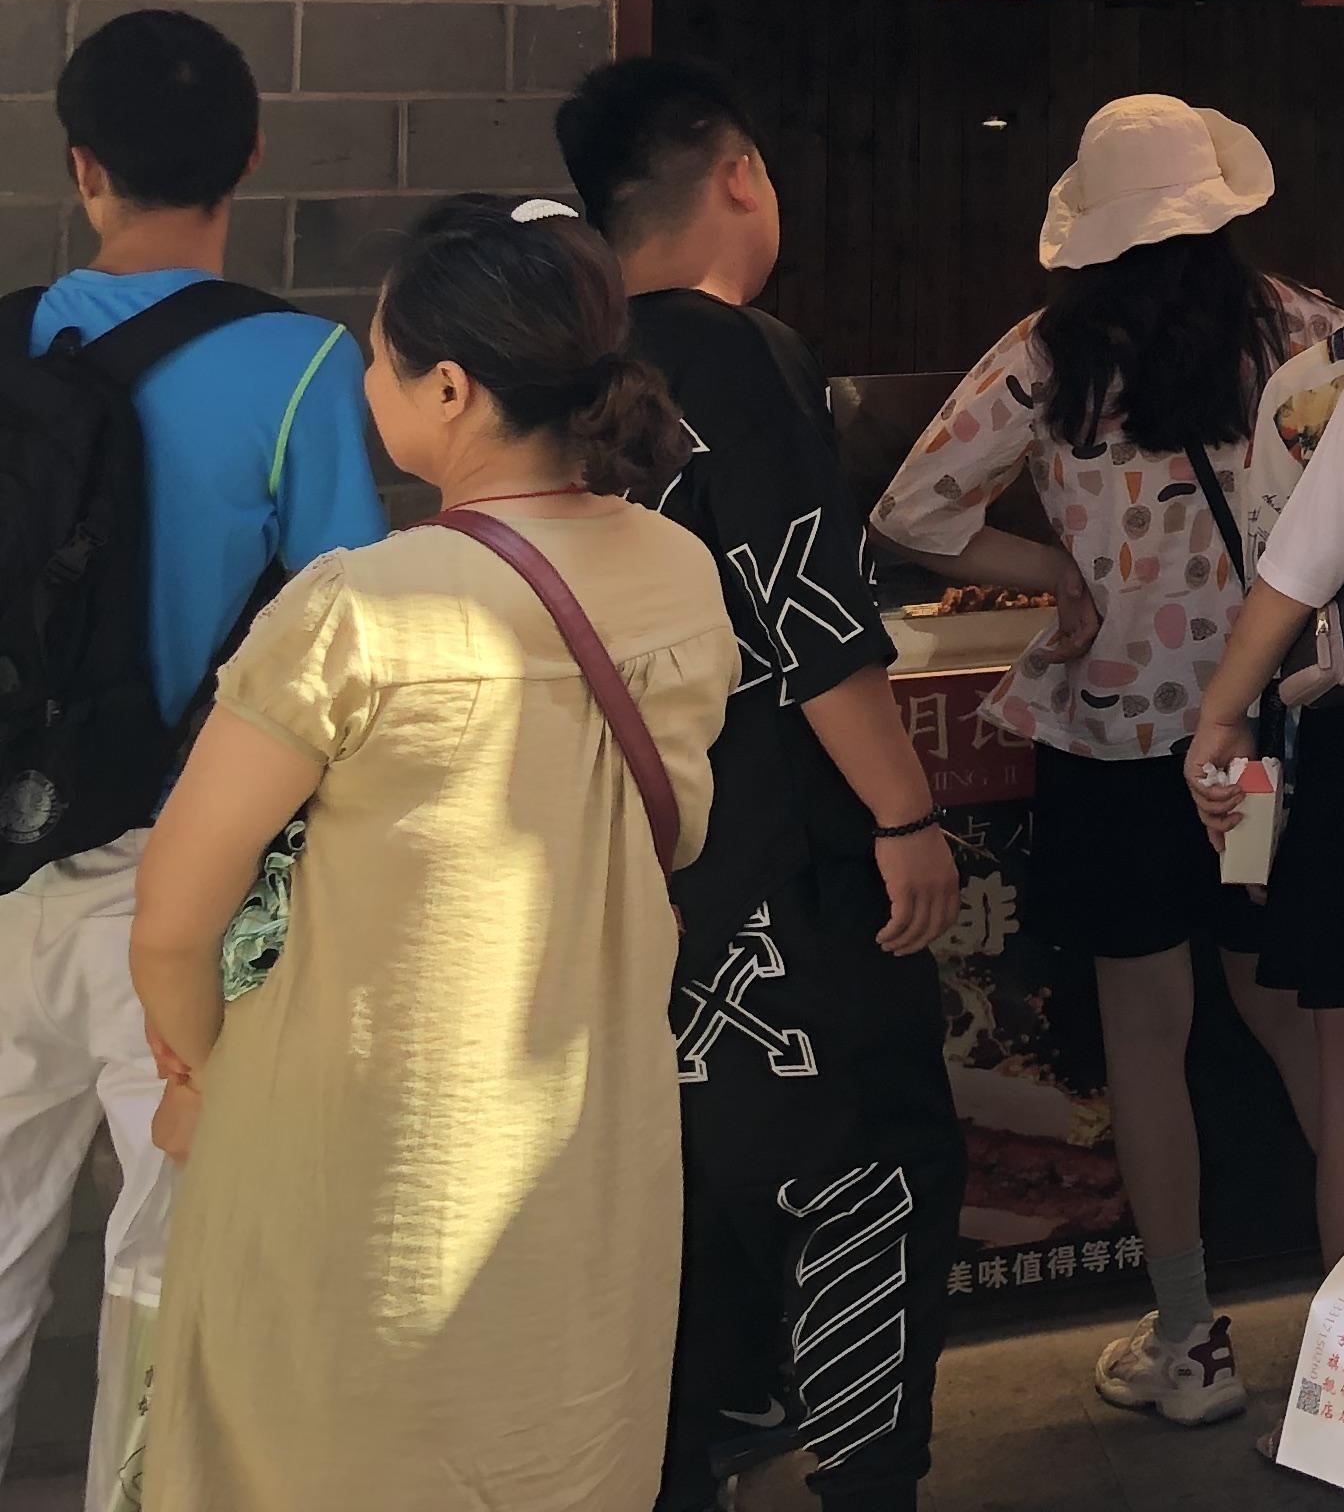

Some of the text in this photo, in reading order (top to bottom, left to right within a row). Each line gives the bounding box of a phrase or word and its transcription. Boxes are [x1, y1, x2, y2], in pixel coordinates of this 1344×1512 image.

[946, 1234, 1146, 1296] 美味值得等待
